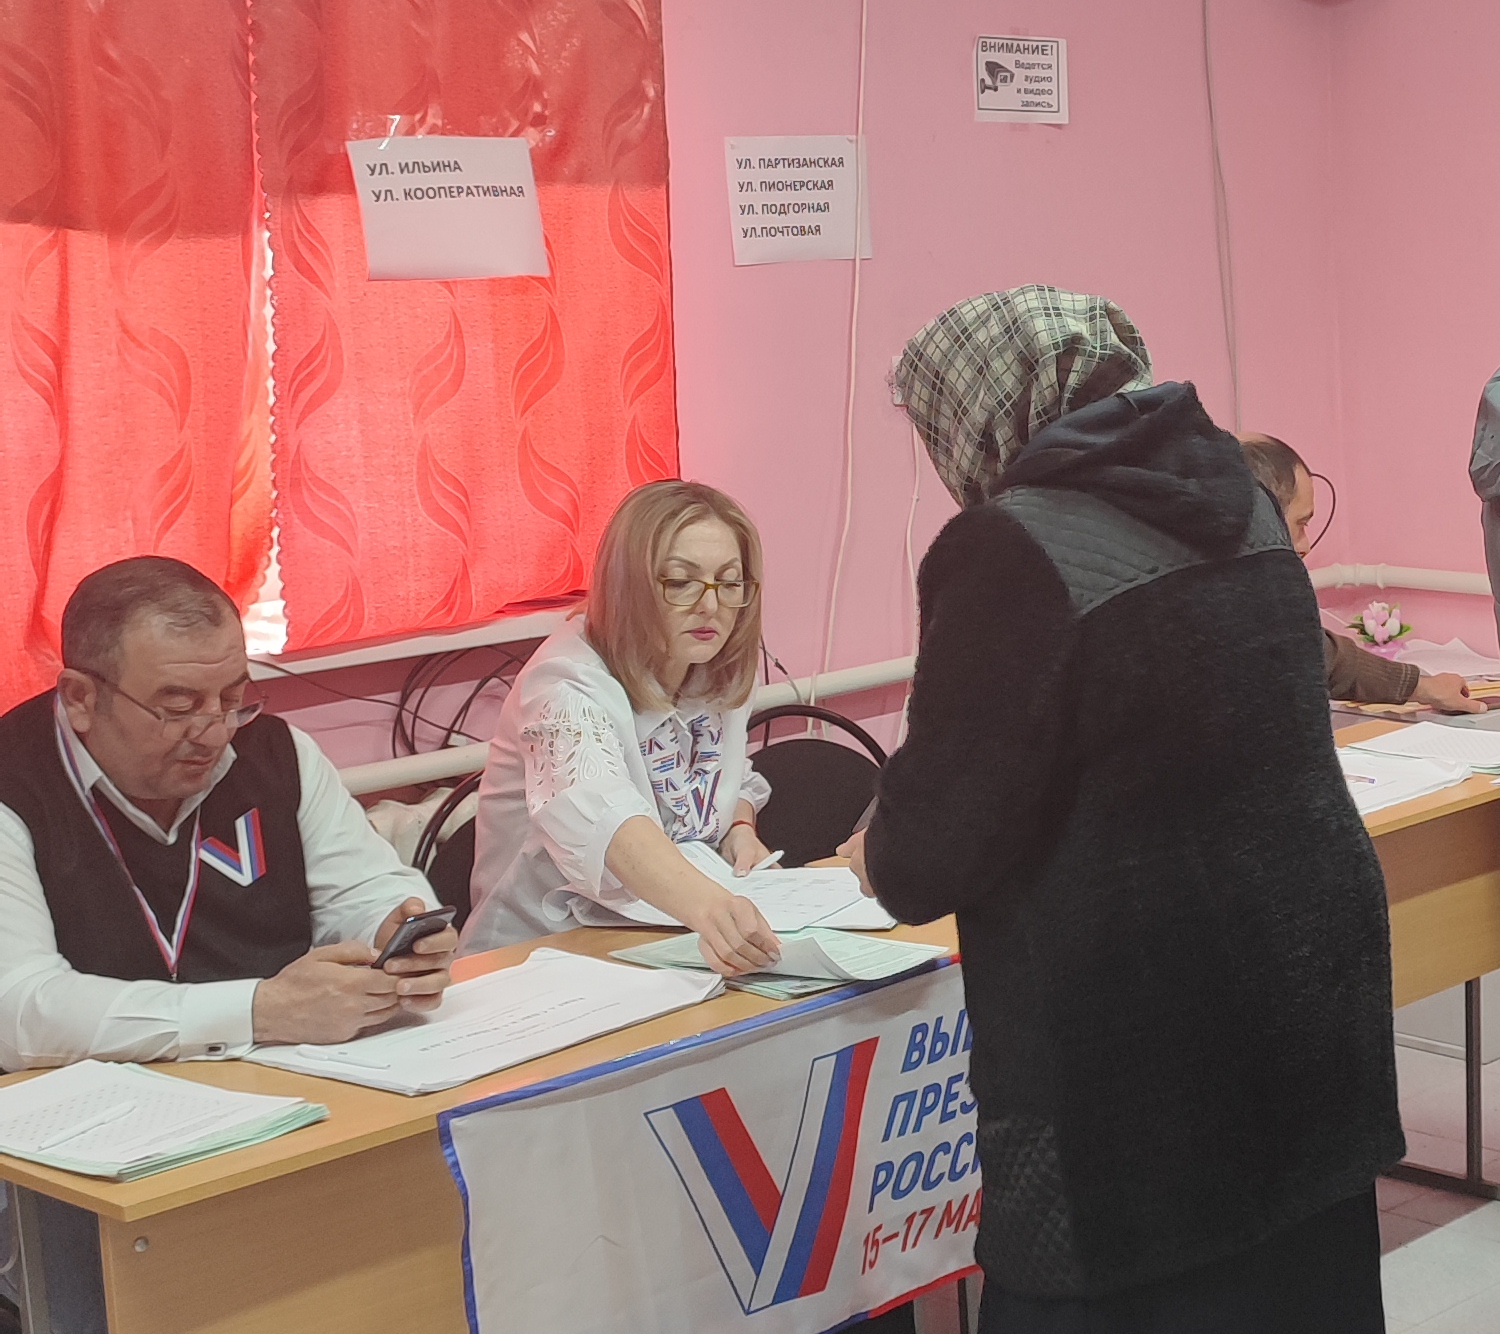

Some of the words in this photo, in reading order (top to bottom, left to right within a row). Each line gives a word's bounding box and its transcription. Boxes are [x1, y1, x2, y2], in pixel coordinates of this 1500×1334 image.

[981, 41, 1053, 56] ВНИМАНИЕ!
[1024, 75, 1053, 84] аудио
[1024, 88, 1053, 96] видео
[1021, 100, 1053, 108] запись
[366, 163, 395, 176] УЛ.
[398, 160, 463, 174] ИЛЬИНА
[736, 158, 755, 169] УЛ.
[758, 157, 844, 169] ПАРТИЗАНСКАЯ
[738, 181, 757, 192] УЛ.
[760, 180, 834, 191] ПИОНЕРСКАЯ
[371, 189, 399, 202] УЛ.
[403, 185, 525, 201] КООПЕРАТИВНАЯ
[739, 204, 759, 215] УЛ.
[761, 202, 830, 216] ПОДГОРНАЯ
